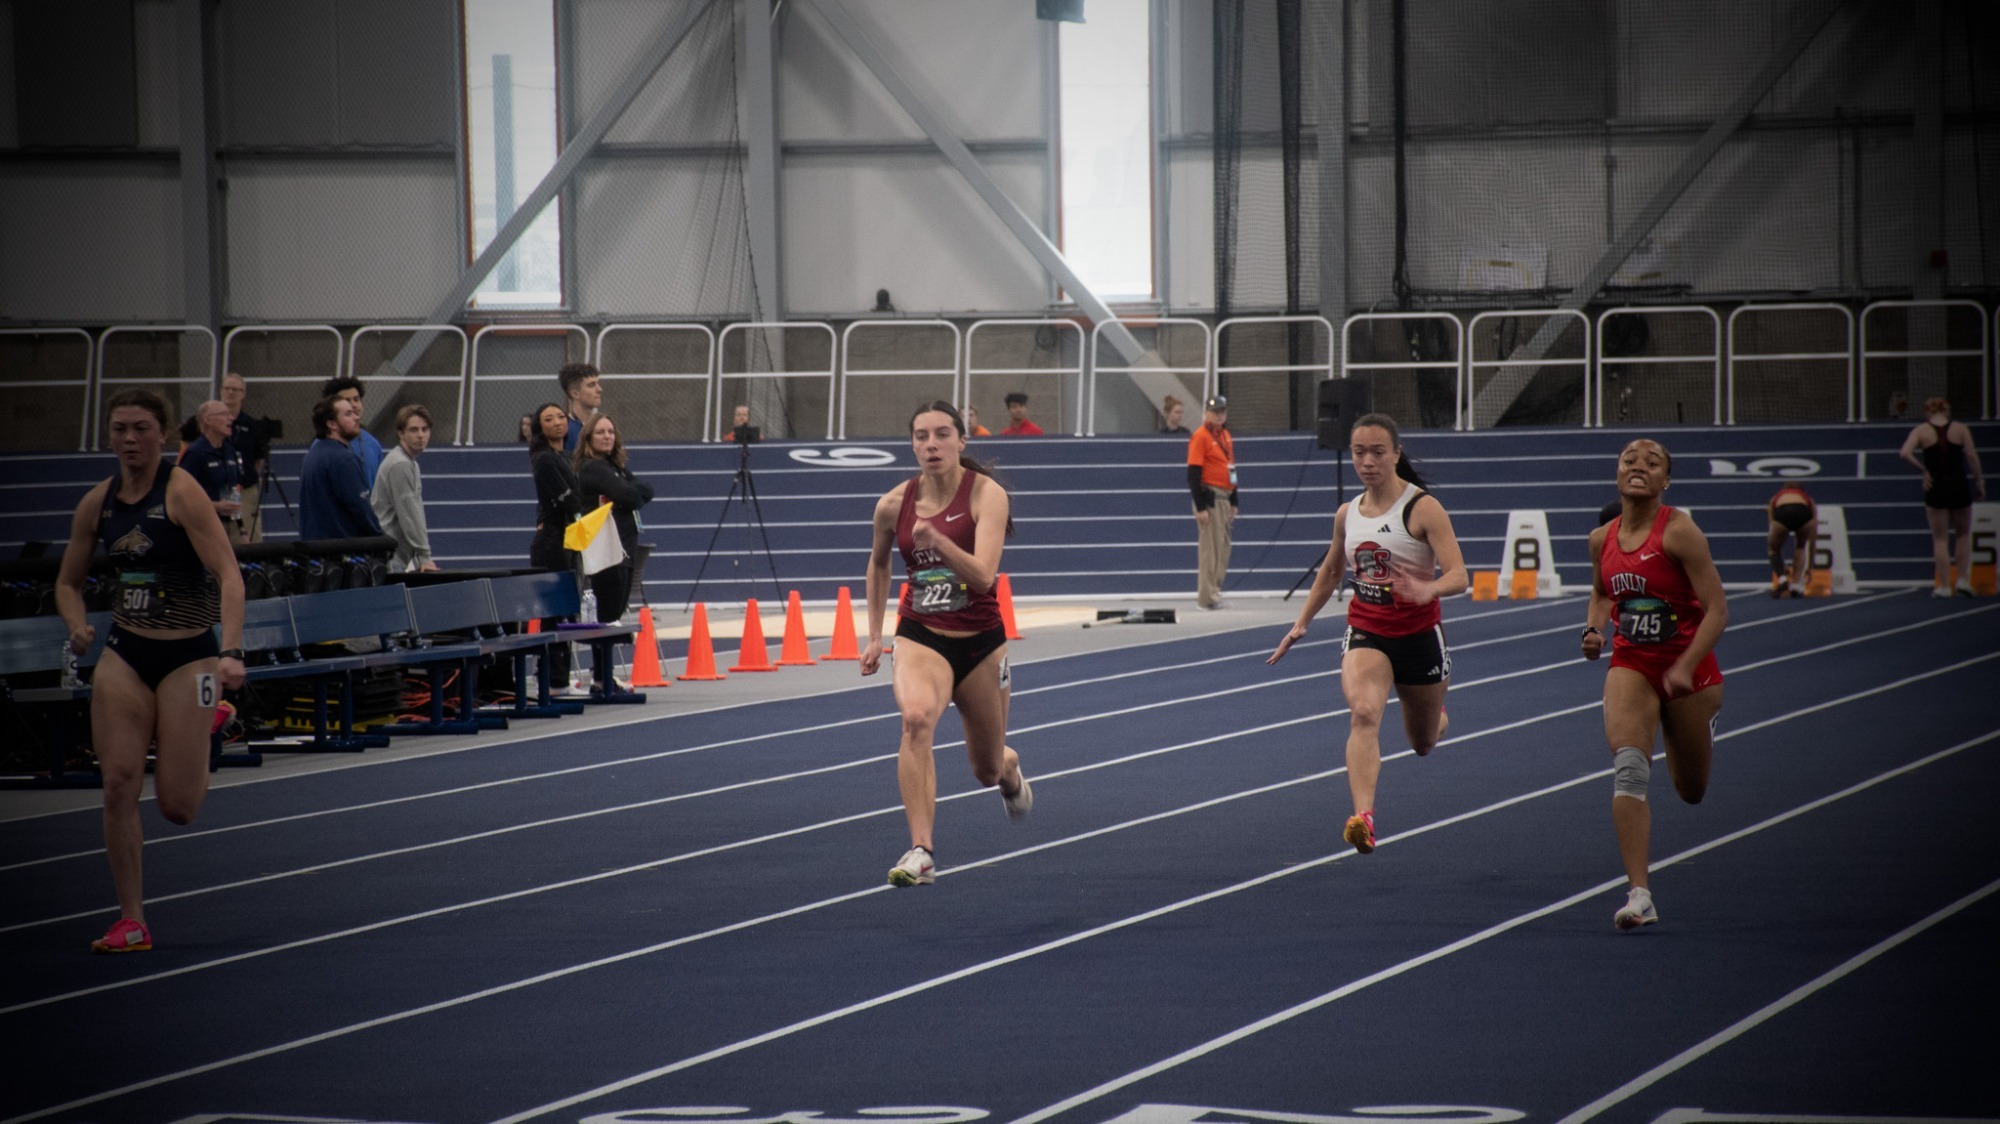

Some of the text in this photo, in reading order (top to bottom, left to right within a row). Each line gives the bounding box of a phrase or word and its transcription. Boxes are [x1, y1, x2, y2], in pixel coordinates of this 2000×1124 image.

[1514, 538, 1541, 571] 8
[1972, 532, 1997, 565] 5
[920, 582, 953, 607] 222
[1610, 572, 1648, 596] UNLV
[122, 588, 150, 611] 501
[1629, 612, 1661, 637] 745
[201, 675, 213, 706] 6
